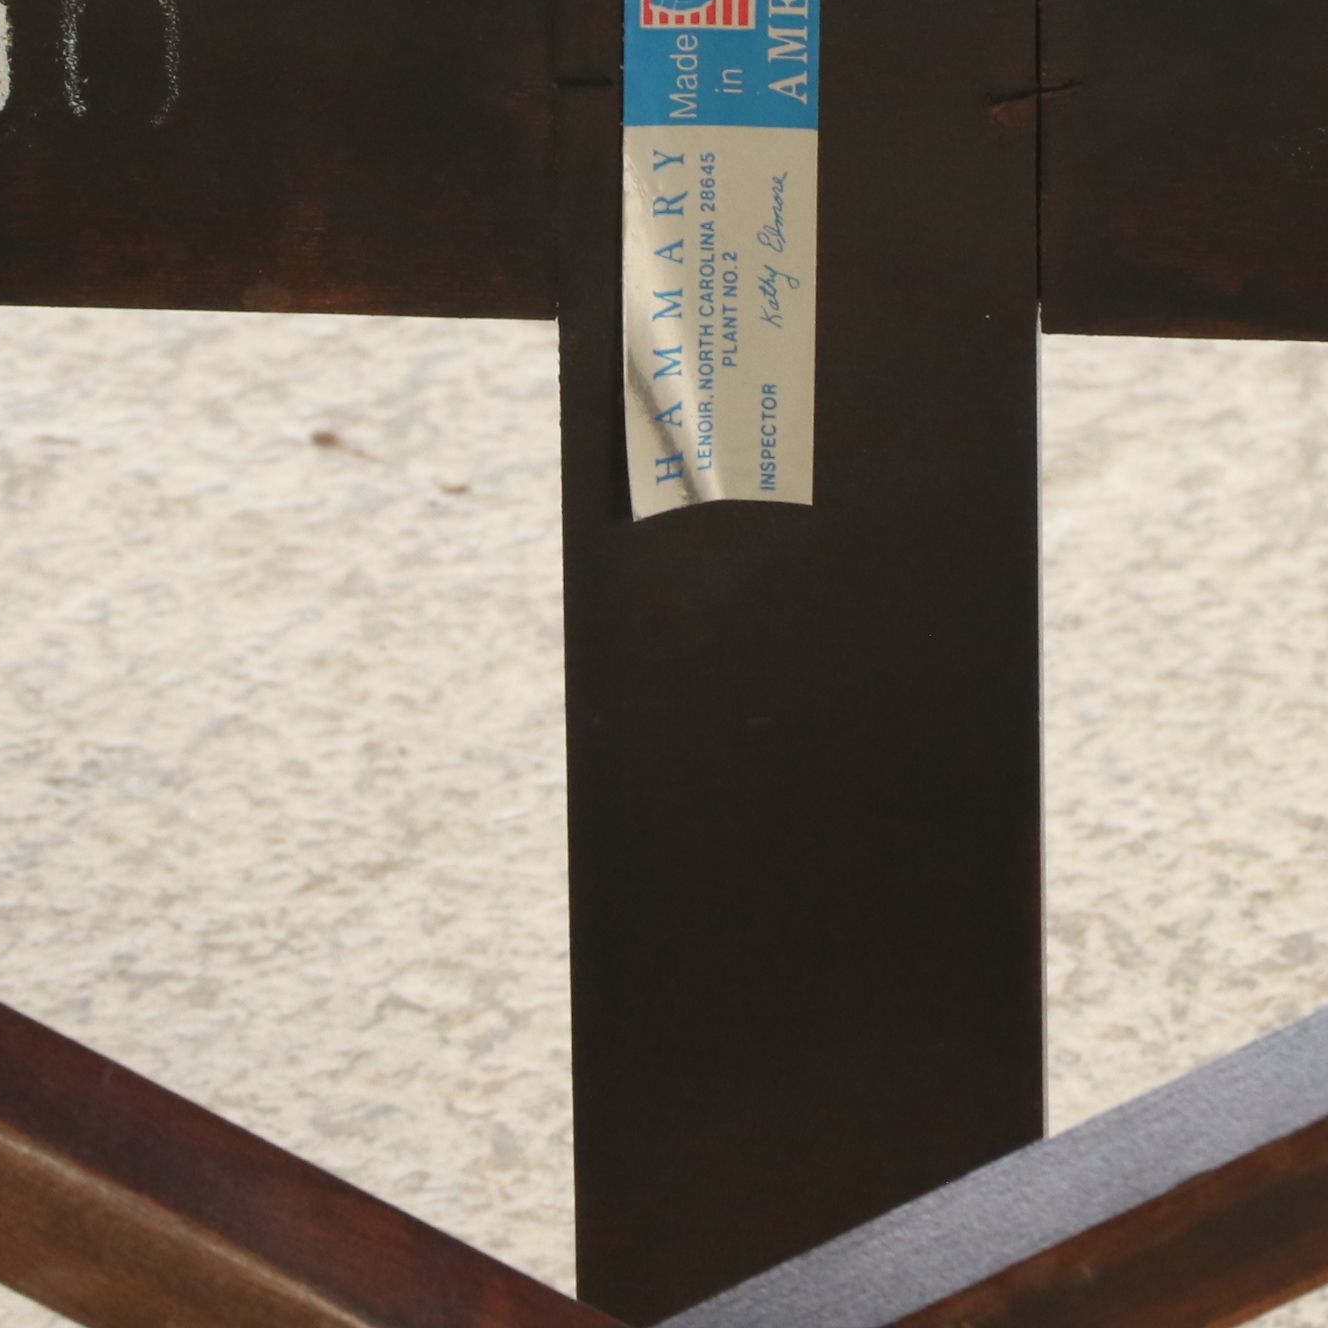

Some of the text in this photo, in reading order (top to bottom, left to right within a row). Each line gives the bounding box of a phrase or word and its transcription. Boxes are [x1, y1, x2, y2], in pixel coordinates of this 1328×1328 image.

[669, 33, 698, 119] Made
[714, 68, 743, 94] in
[700, 151, 717, 212] 28645
[698, 219, 715, 319] CAROLINA
[756, 171, 800, 329] Kathy Elmore
[652, 149, 689, 486] HAMMARY
[698, 321, 715, 390] NORTH
[721, 304, 737, 367] PLANT
[760, 382, 778, 491] INSPECTOR
